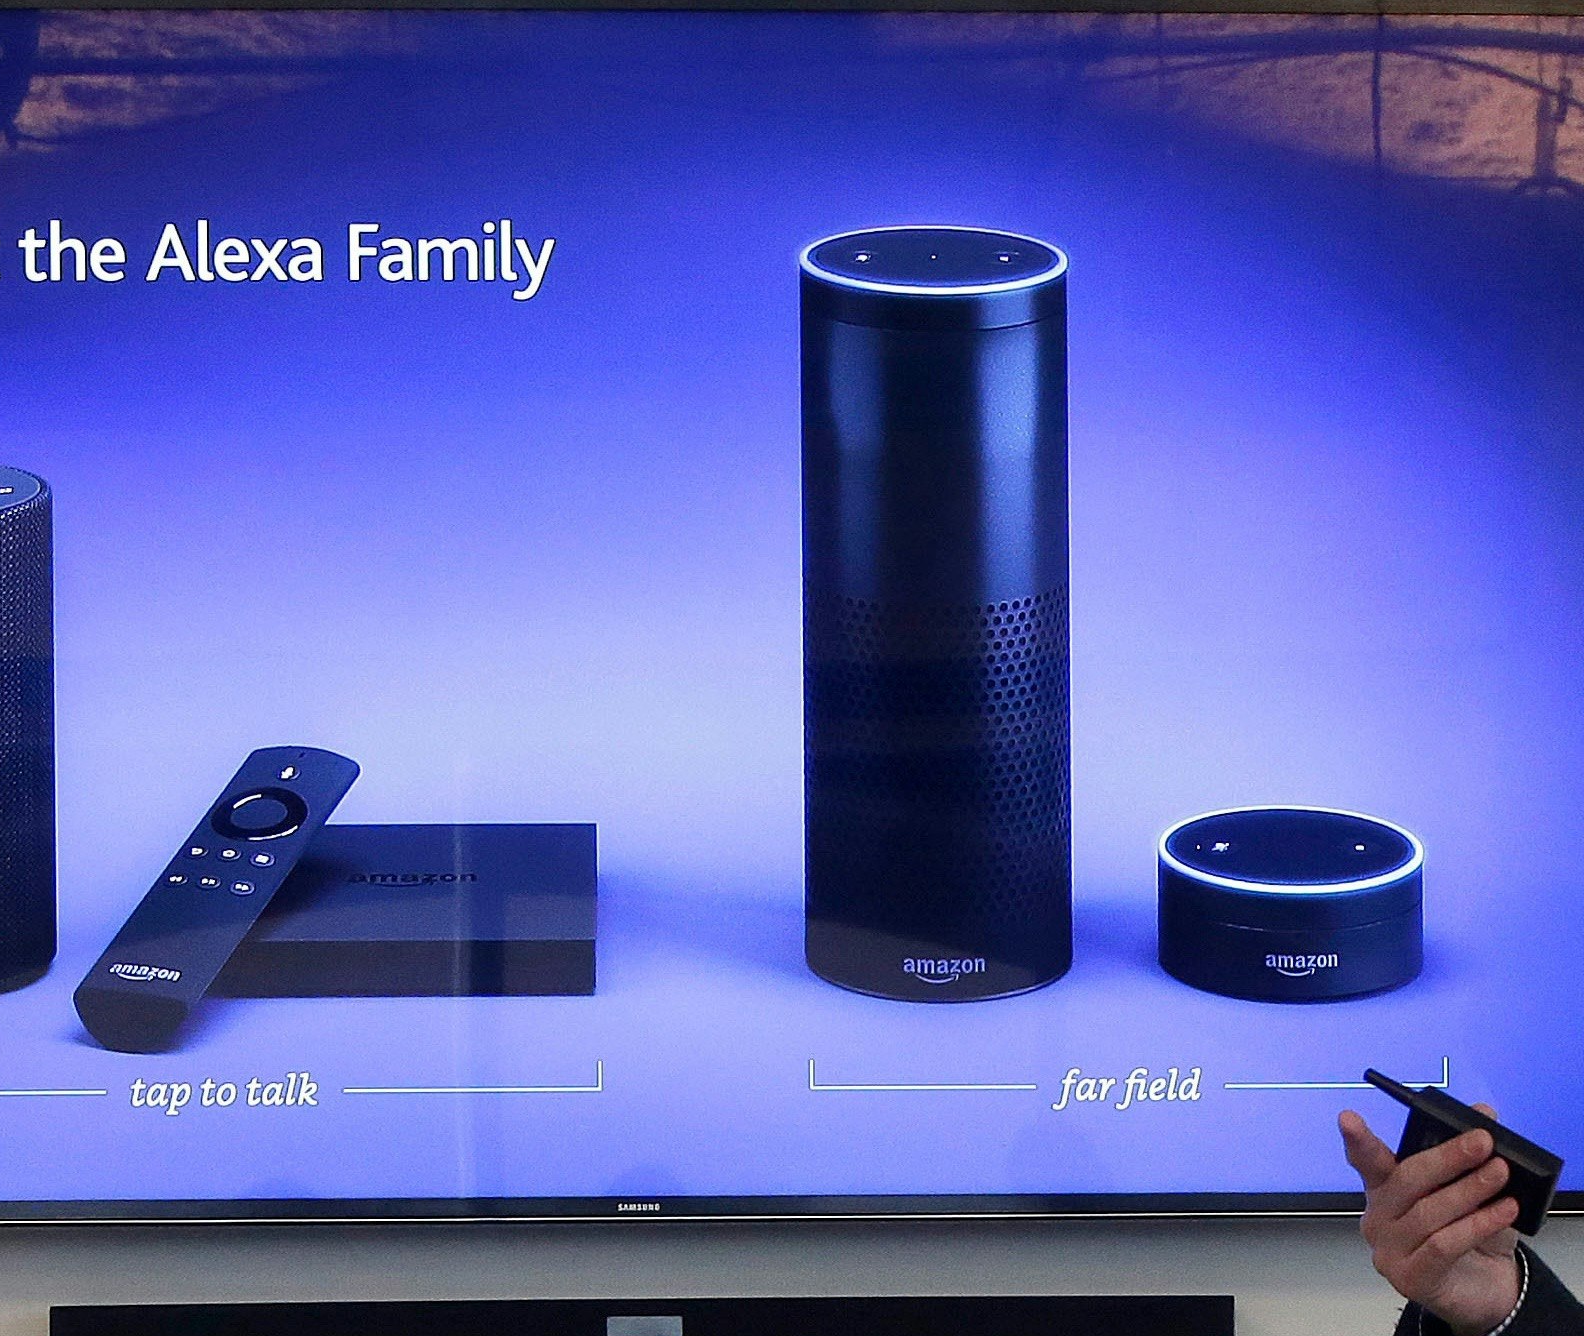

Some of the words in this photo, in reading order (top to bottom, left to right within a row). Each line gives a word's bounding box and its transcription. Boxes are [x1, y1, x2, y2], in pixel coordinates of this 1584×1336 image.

[18, 219, 127, 282] the
[145, 219, 323, 282] Alexa
[348, 219, 556, 301] Family
[347, 873, 478, 885] amazon
[903, 955, 986, 975] amazon
[1264, 951, 1339, 971] amazon
[109, 963, 181, 982] amazon
[130, 1078, 192, 1116] tap
[200, 1078, 237, 1107] to
[245, 1072, 319, 1106] talk
[1051, 1067, 1116, 1111] far
[1115, 1067, 1202, 1111] field
[617, 1203, 661, 1212] SAMSUNG
